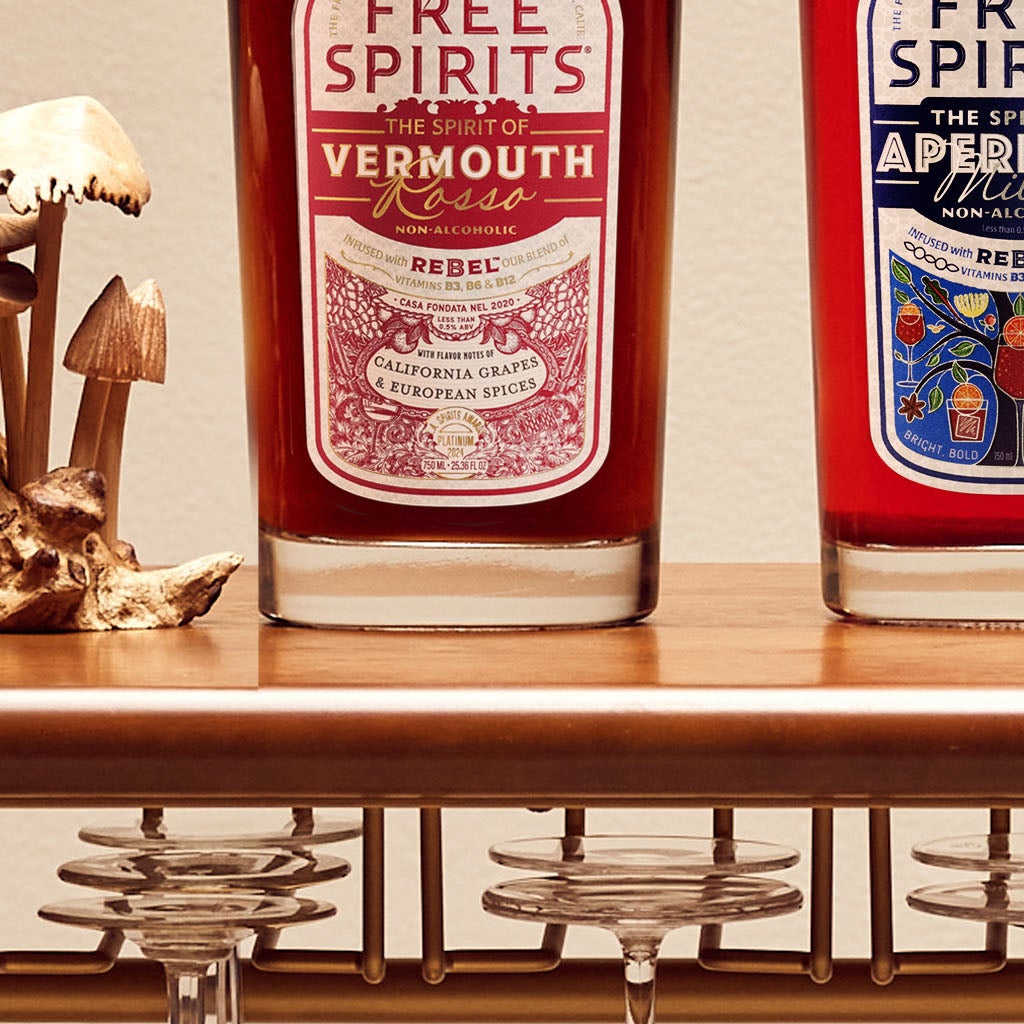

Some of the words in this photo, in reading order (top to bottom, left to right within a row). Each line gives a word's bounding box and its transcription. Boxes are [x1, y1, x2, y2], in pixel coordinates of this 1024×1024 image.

[329, 16, 338, 37] THE
[892, 10, 901, 31] THE
[384, 118, 424, 136] THE
[431, 119, 497, 136] SPIRIT
[501, 119, 529, 136] OF
[931, 109, 979, 126] THE
[321, 143, 594, 179] VERMOUTH
[369, 154, 537, 220] Rosso
[395, 224, 518, 236] NON-ALCOHOLIC
[343, 234, 385, 260] INFUSED
[385, 254, 408, 269] with
[502, 255, 526, 269] OUR
[526, 242, 558, 262] BLEND
[558, 233, 569, 248] of
[908, 226, 949, 253] INFUSED
[951, 245, 974, 260] with
[395, 275, 443, 292] VITAMINS
[466, 280, 482, 291] B6
[484, 278, 494, 289] &
[496, 275, 517, 287] B12
[960, 266, 1009, 282] VITAMINS
[400, 297, 424, 311] CASA
[426, 303, 468, 313] FONDATA
[470, 303, 488, 312] NEL
[491, 298, 515, 311] 2020
[418, 349, 435, 358] WITH
[437, 351, 462, 361] FLAVOR
[463, 350, 485, 361] NOTES
[486, 349, 495, 358] OF
[374, 355, 474, 380] CALIFORNIA
[478, 356, 540, 379] GRAPES
[375, 376, 385, 389] &
[390, 380, 478, 400] EUROPEAN
[483, 377, 537, 398] SPICES
[437, 435, 475, 447] PLATINUM
[903, 429, 944, 458] BRIGHT,
[949, 447, 979, 461] BOLD
[423, 460, 436, 471] 750
[436, 460, 447, 471] ML
[470, 460, 478, 471] FL
